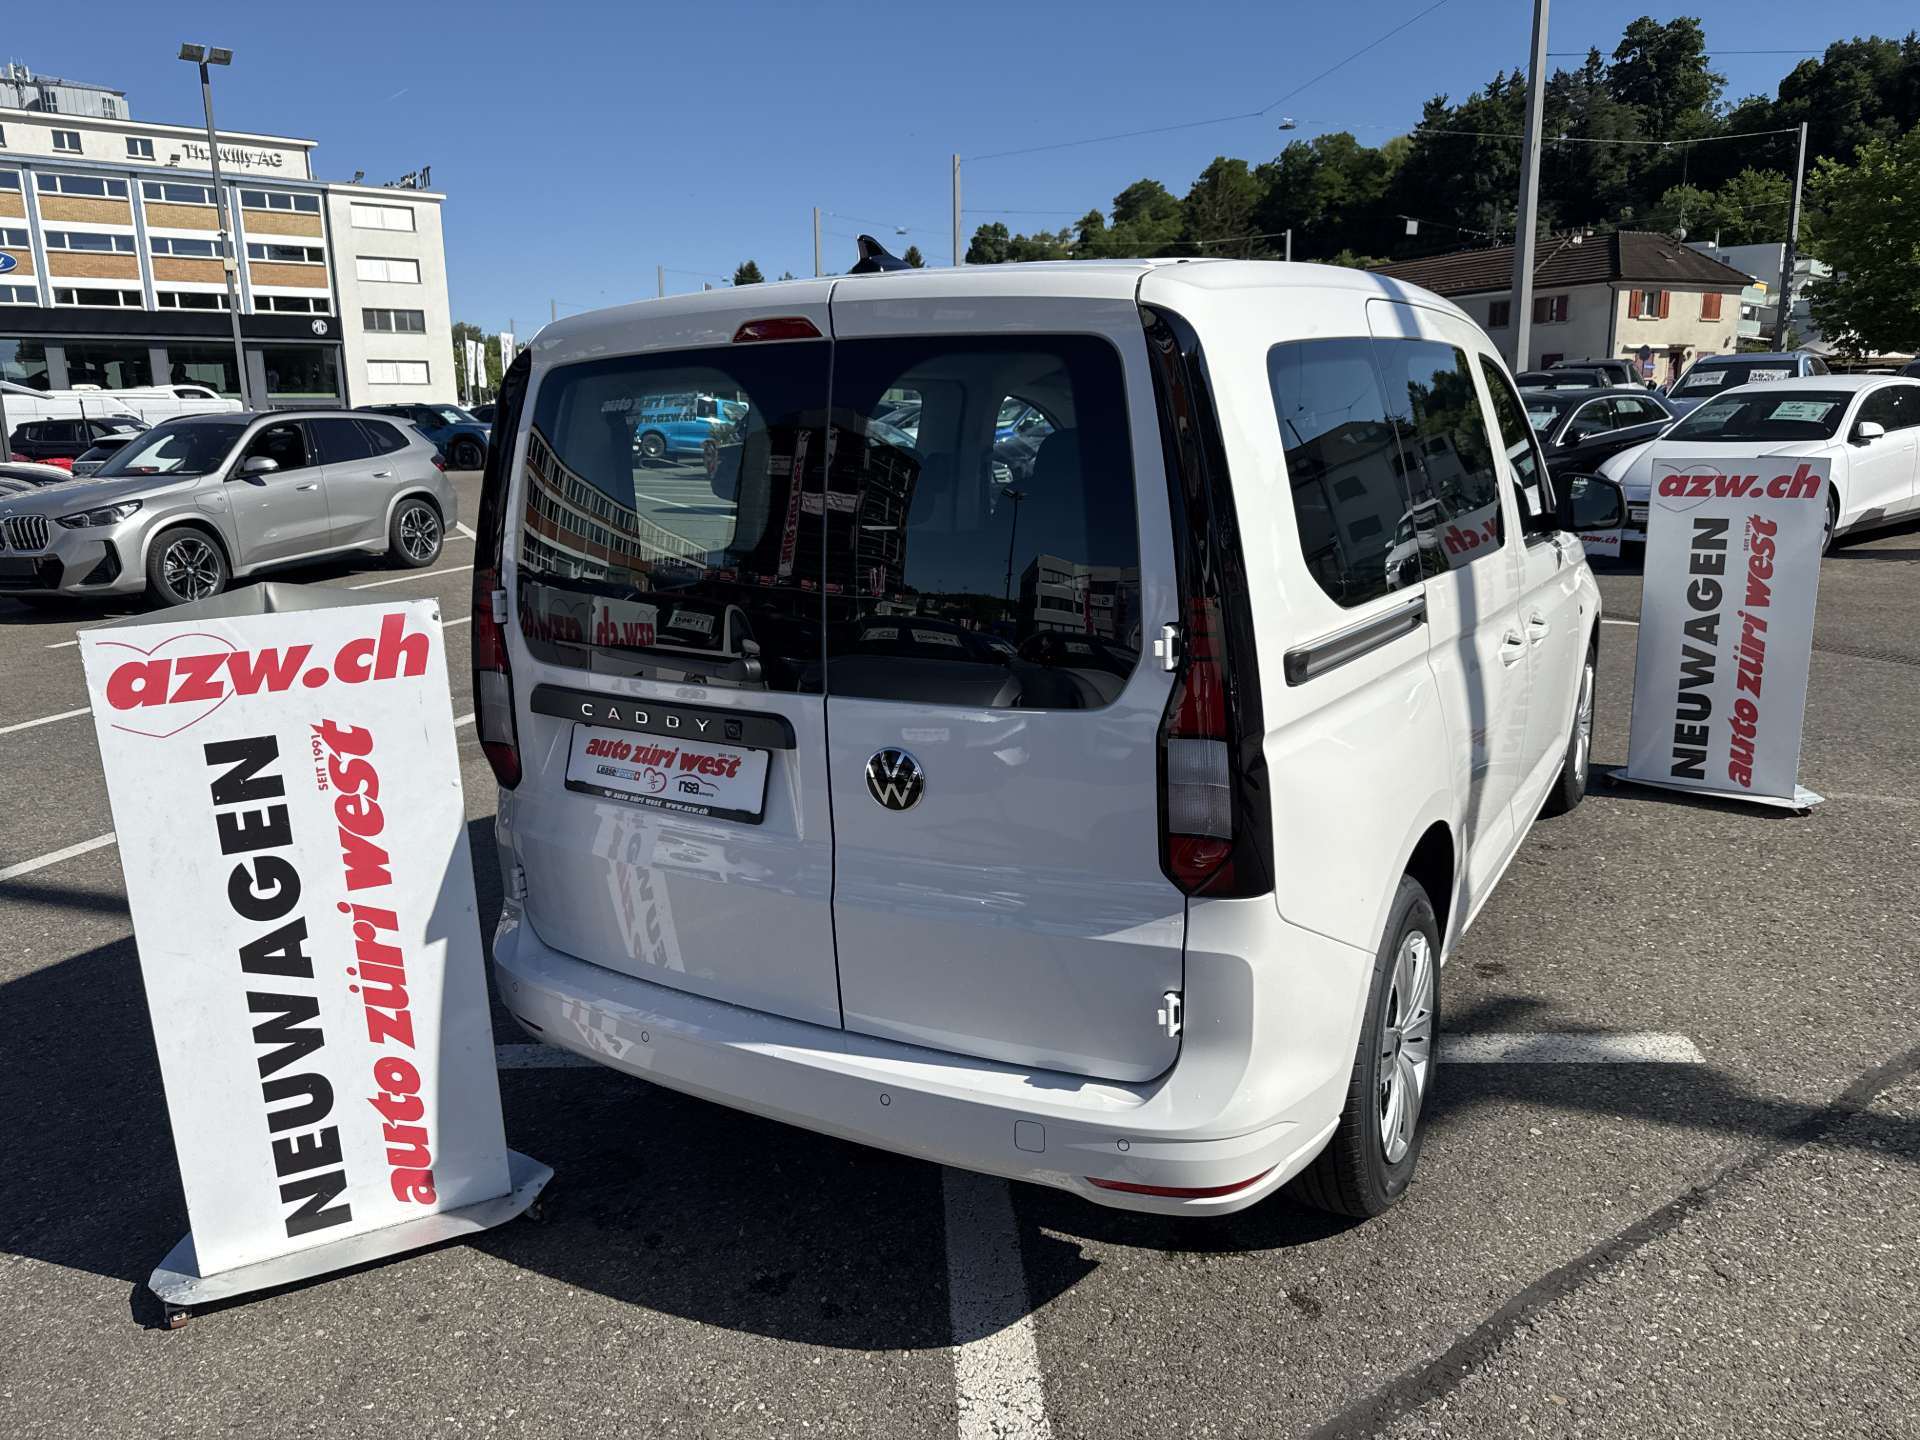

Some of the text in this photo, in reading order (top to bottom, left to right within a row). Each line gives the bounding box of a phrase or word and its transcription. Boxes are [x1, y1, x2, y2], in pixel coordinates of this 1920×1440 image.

[258, 151, 283, 168] AG
[1658, 464, 1821, 498] azw.ch
[106, 613, 430, 711] azw.ch
[1671, 517, 1730, 781] NEUWAGEN
[1728, 514, 1778, 788] auto züri west
[581, 703, 710, 732] CADDY
[310, 734, 329, 792] SEIT 1991
[585, 737, 742, 779] auto züri west
[678, 779, 700, 795] nsa
[203, 734, 352, 1239] NEUWAGEN
[309, 718, 437, 1205] auto züri west
